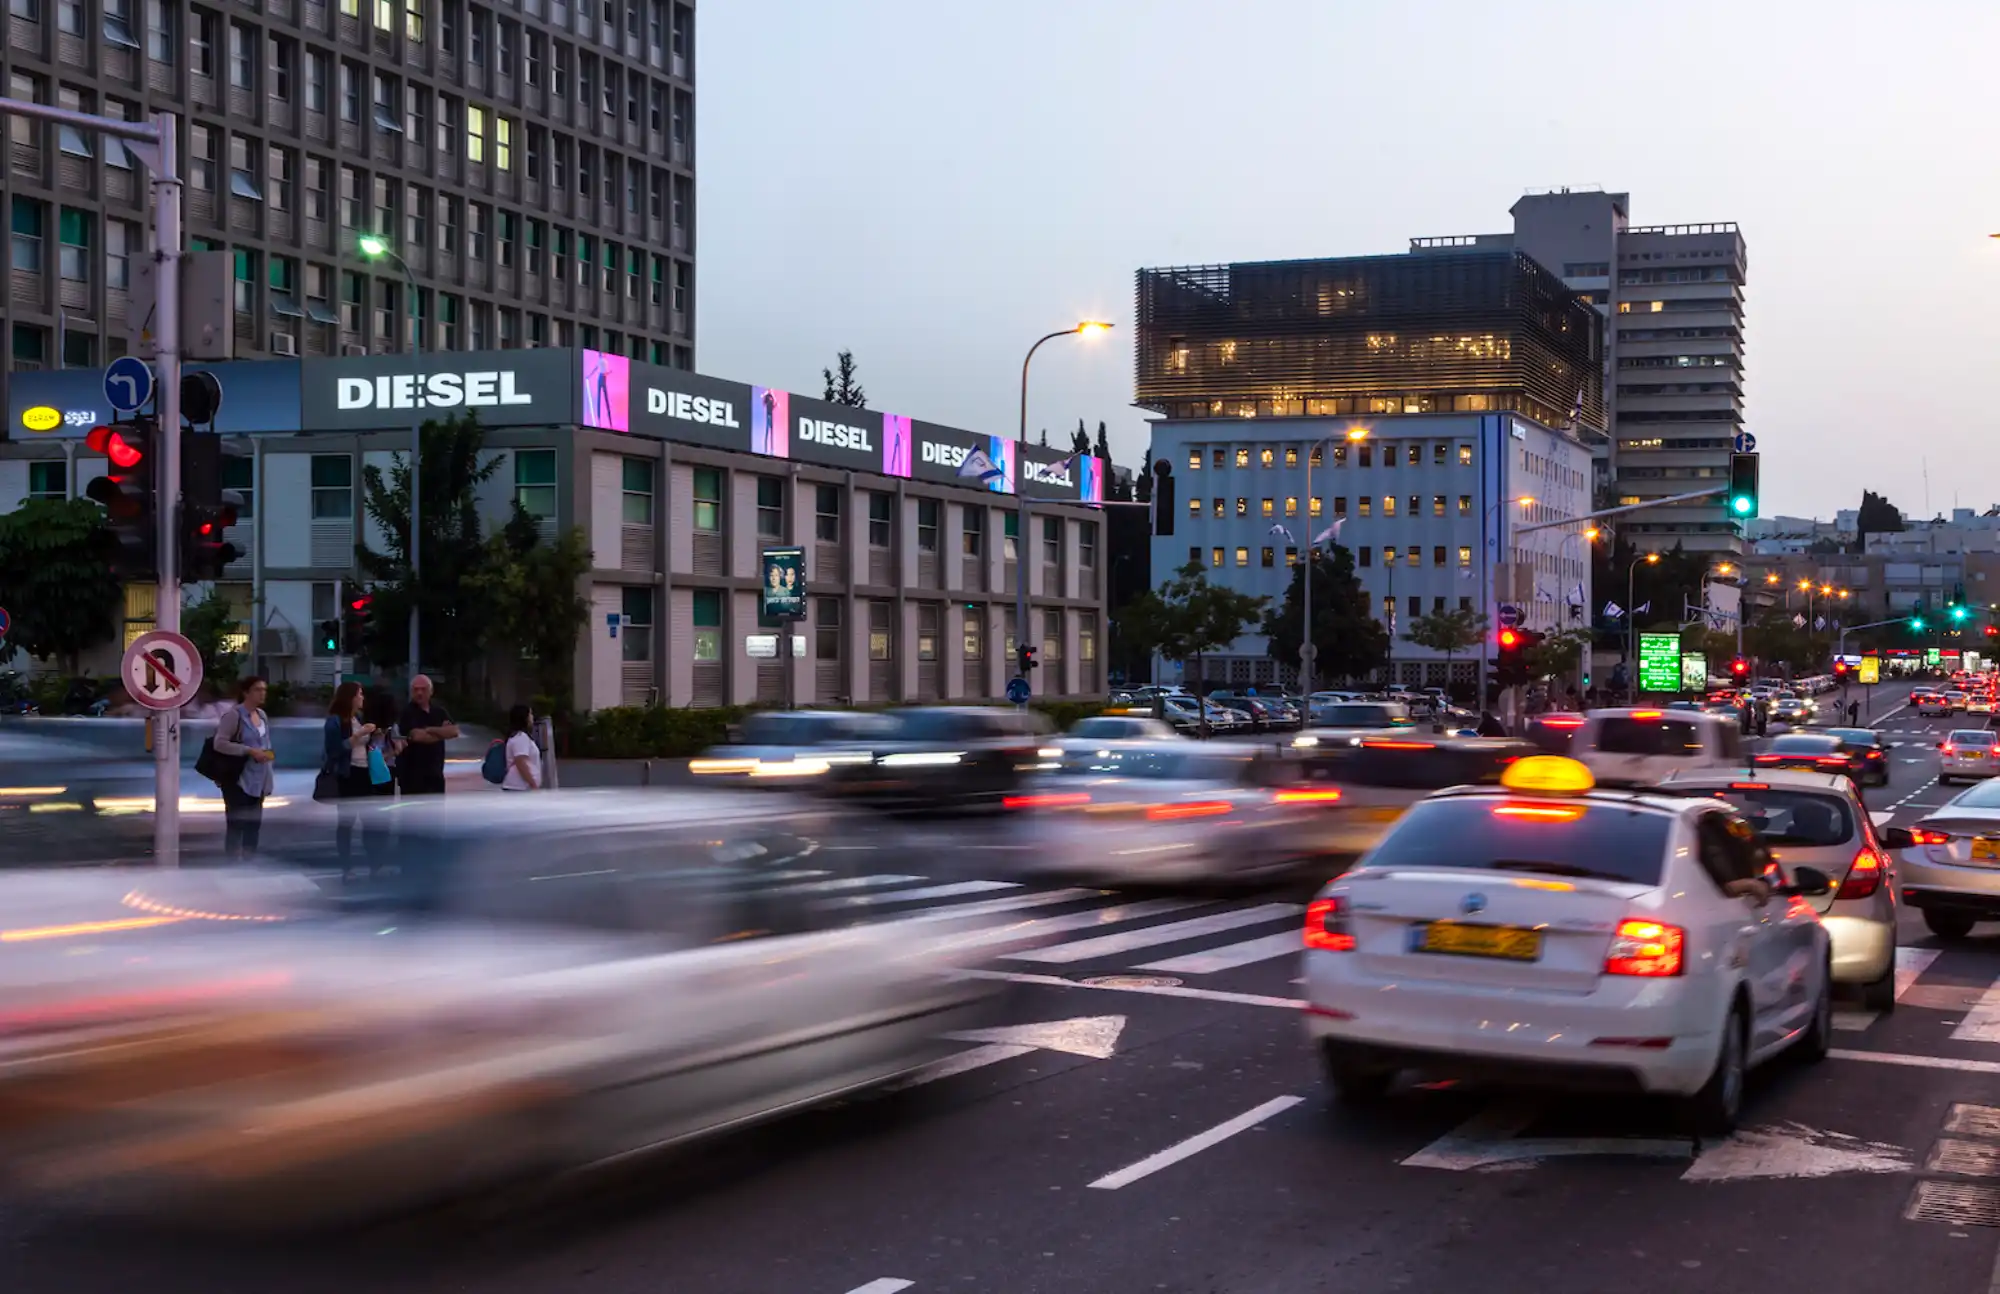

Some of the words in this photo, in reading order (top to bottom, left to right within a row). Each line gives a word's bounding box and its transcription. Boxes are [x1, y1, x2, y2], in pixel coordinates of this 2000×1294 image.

[337, 371, 532, 410] DIESEL
[648, 387, 740, 428] DIESEL
[799, 417, 873, 452] DIESEL
